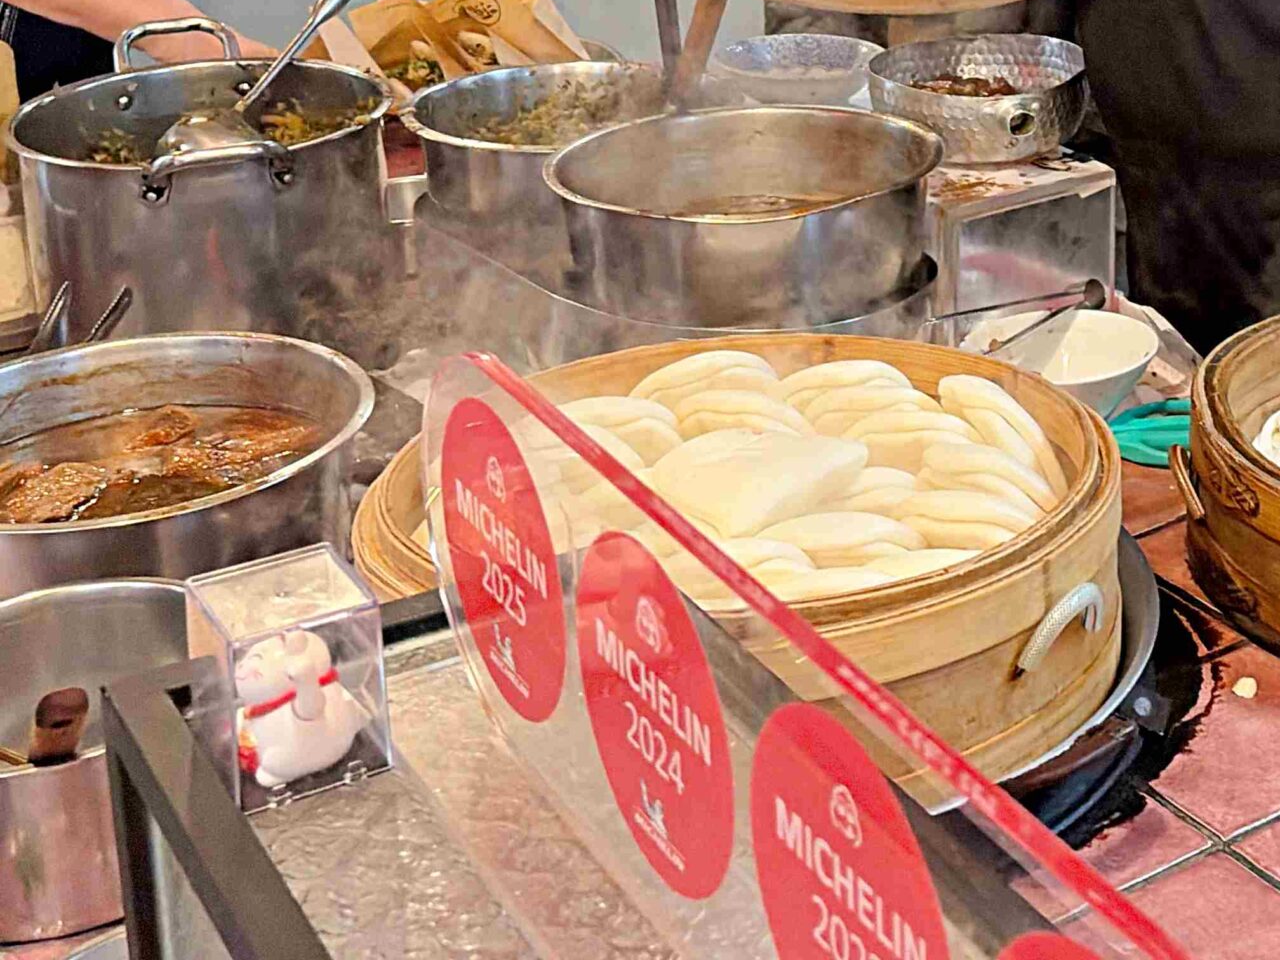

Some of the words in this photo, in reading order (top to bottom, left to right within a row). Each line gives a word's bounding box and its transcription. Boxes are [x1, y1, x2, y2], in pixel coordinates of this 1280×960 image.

[455, 478, 548, 599] MICHELIN
[480, 551, 526, 627] 2025
[595, 617, 712, 767] MICHELIN
[624, 701, 685, 795] 2024
[774, 795, 928, 960] MICHELIN
[810, 894, 882, 960] 202
